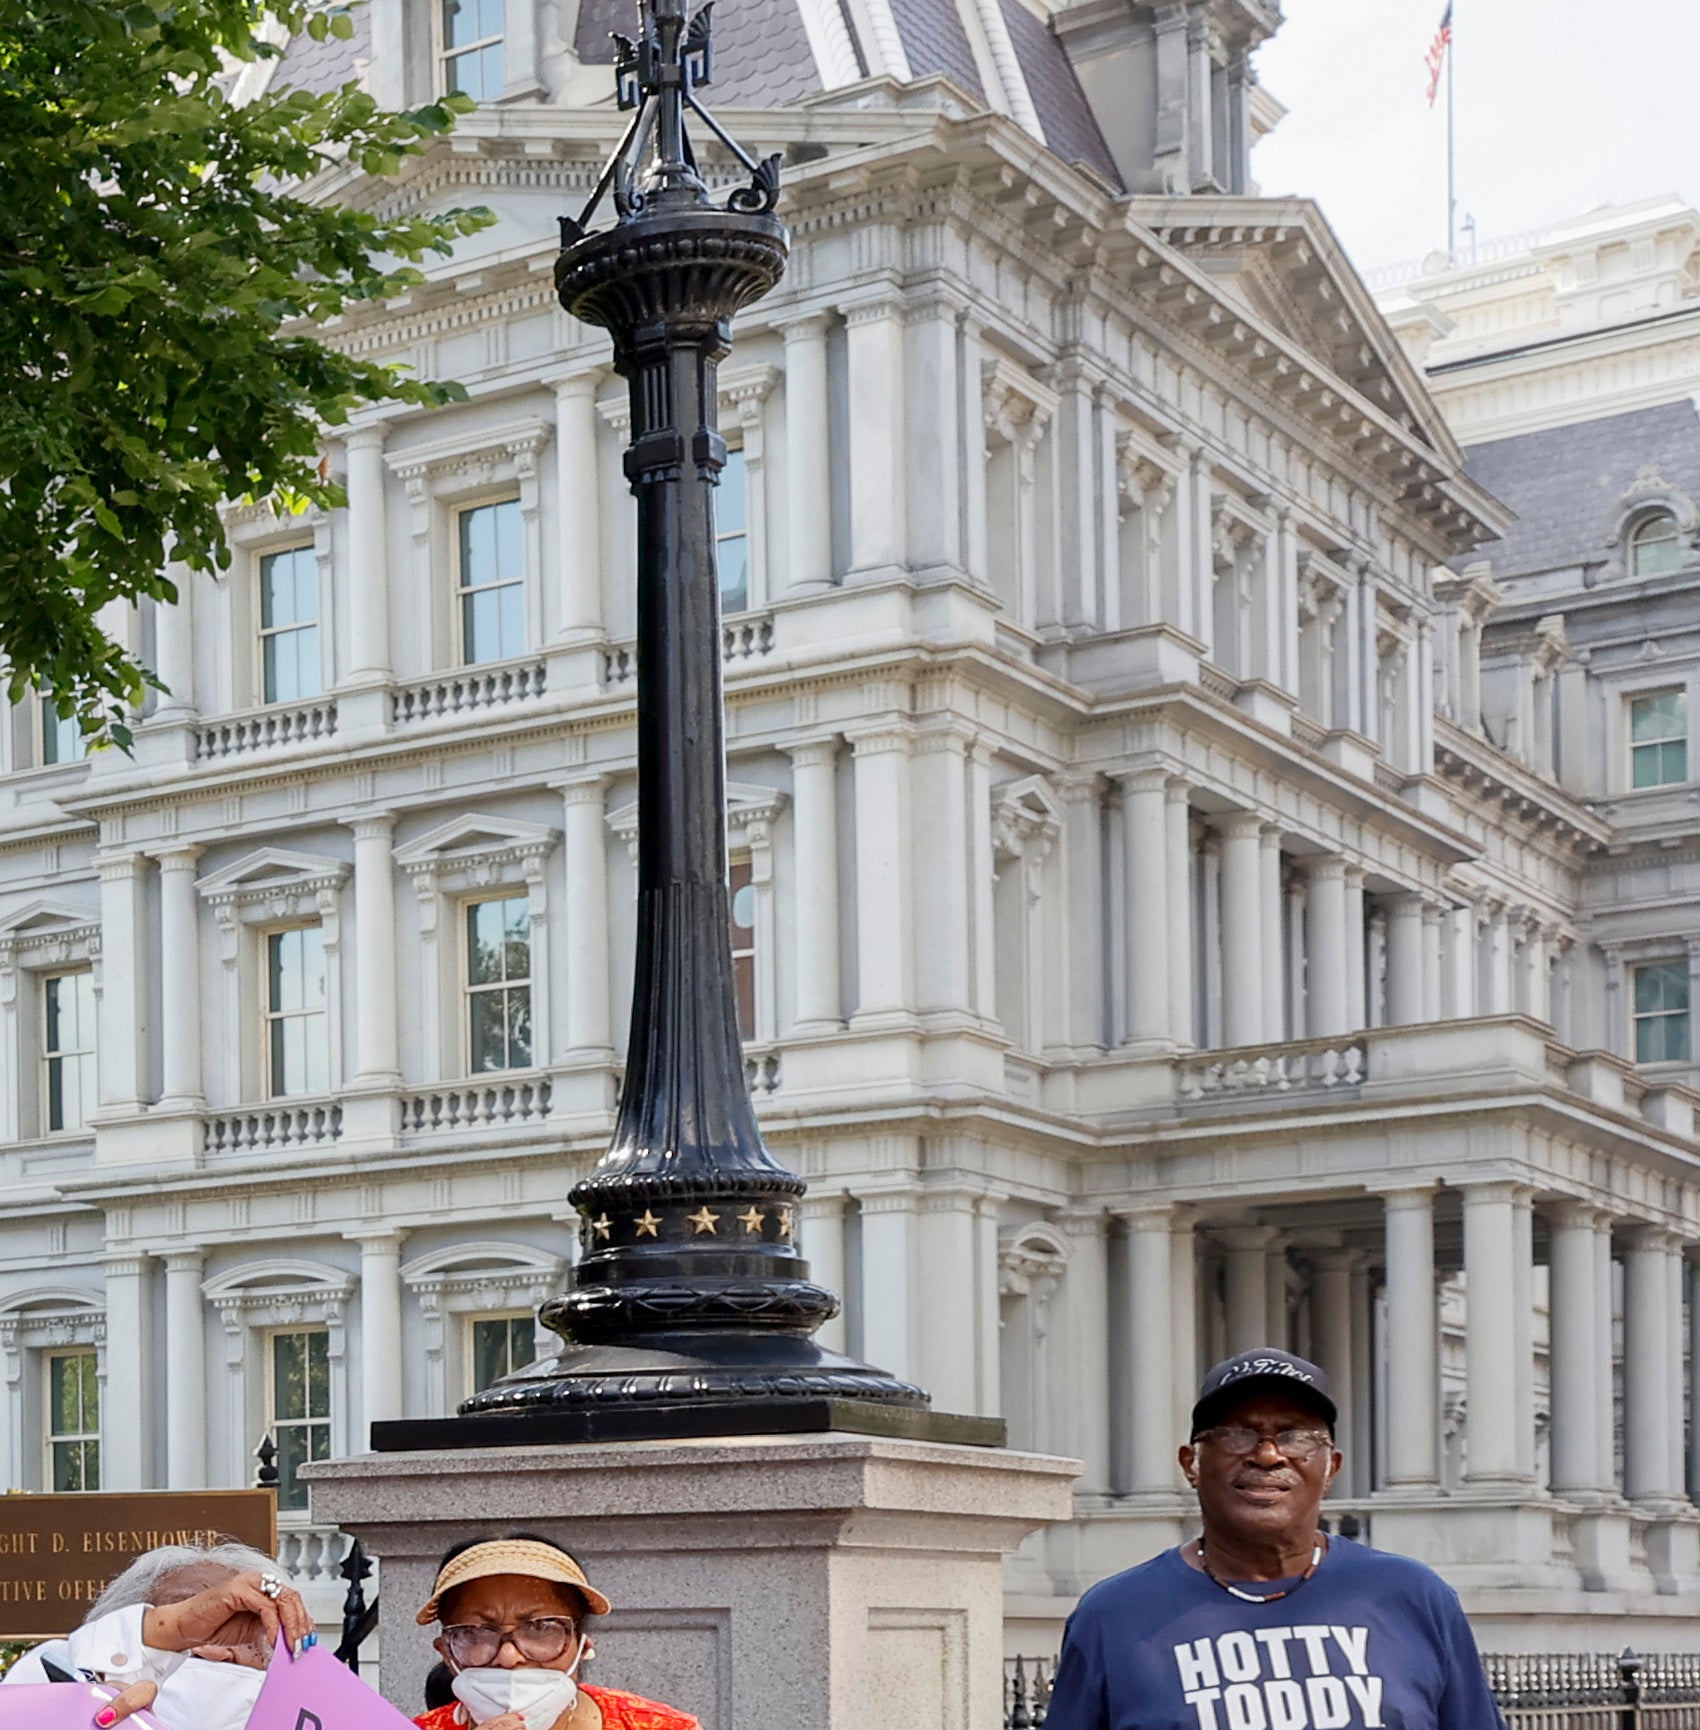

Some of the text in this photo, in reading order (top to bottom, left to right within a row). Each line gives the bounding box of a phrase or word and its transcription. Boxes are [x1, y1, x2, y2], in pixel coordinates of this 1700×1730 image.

[52, 1533, 70, 1553] D.
[83, 1529, 219, 1552] EISENHOWER
[1173, 1625, 1369, 1692] HOTTY
